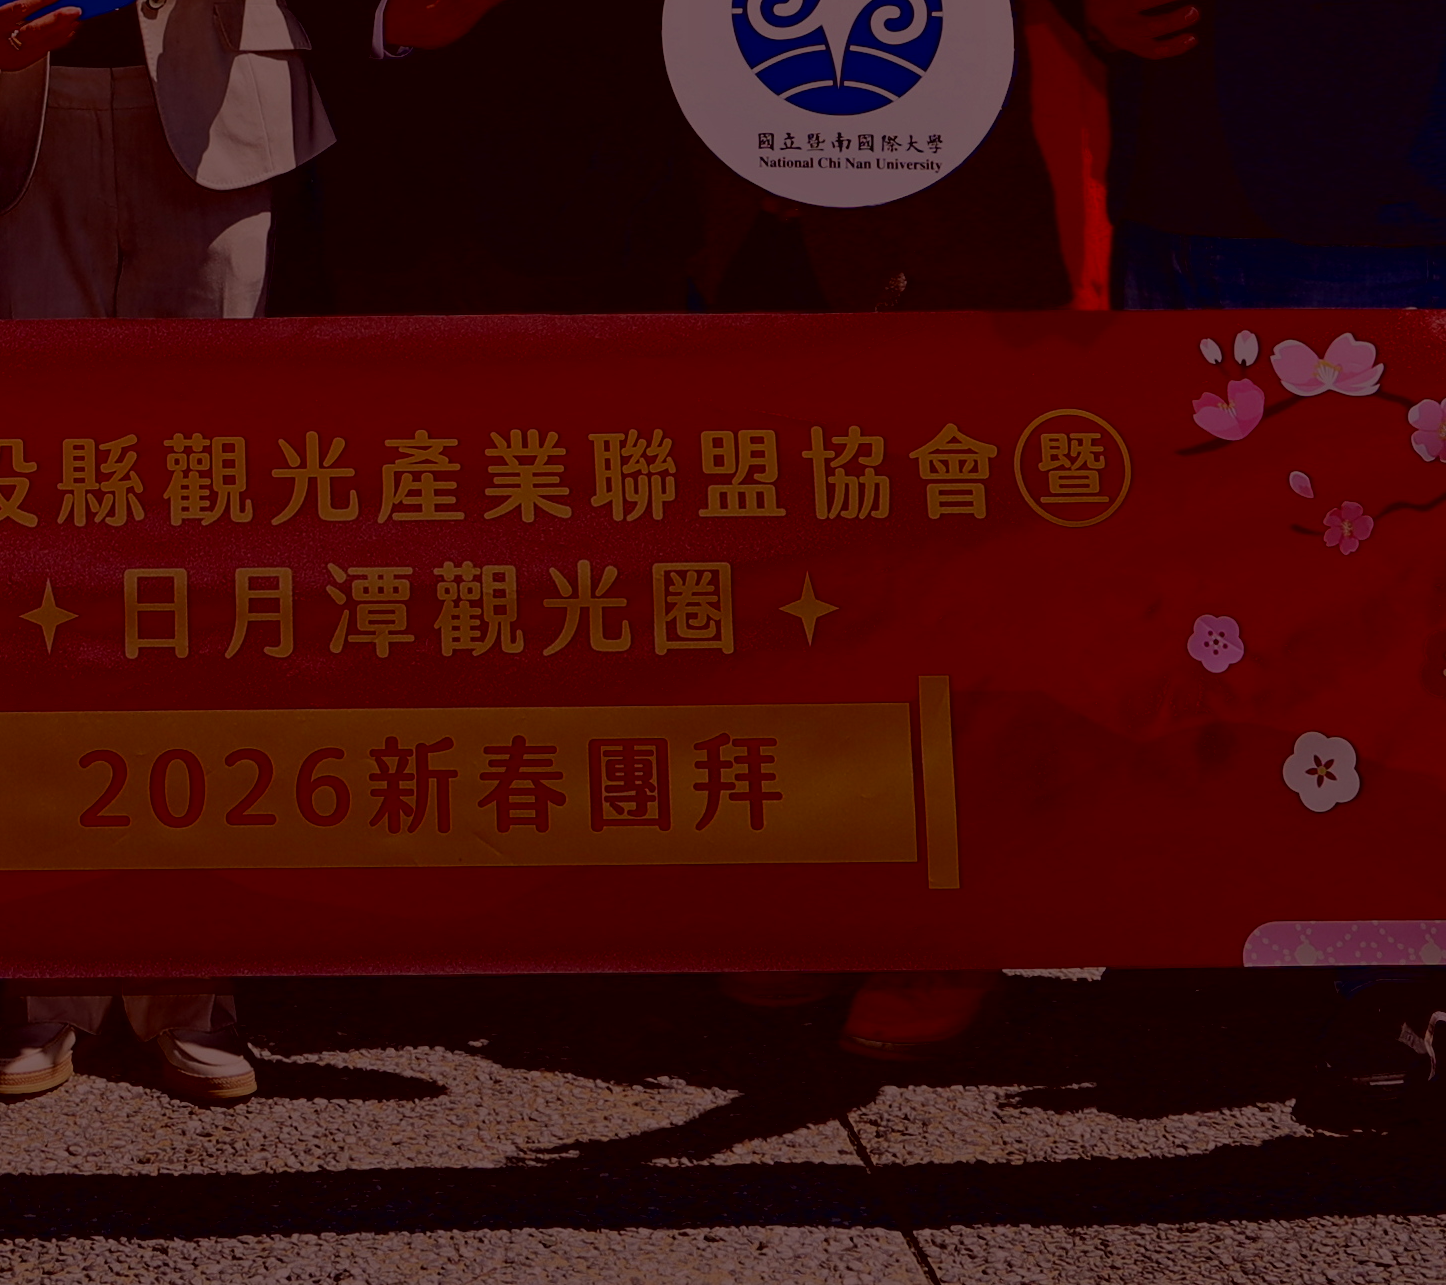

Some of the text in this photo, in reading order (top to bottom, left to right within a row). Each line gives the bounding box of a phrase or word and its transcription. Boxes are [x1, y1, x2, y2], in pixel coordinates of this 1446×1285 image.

[757, 131, 944, 155] 國立暨南國際大學
[759, 155, 944, 174] National Chi Nan University
[1034, 431, 1112, 507] 暨
[119, 559, 737, 662] 日月潭觀光圈
[75, 729, 787, 839] 2026新春團拜
